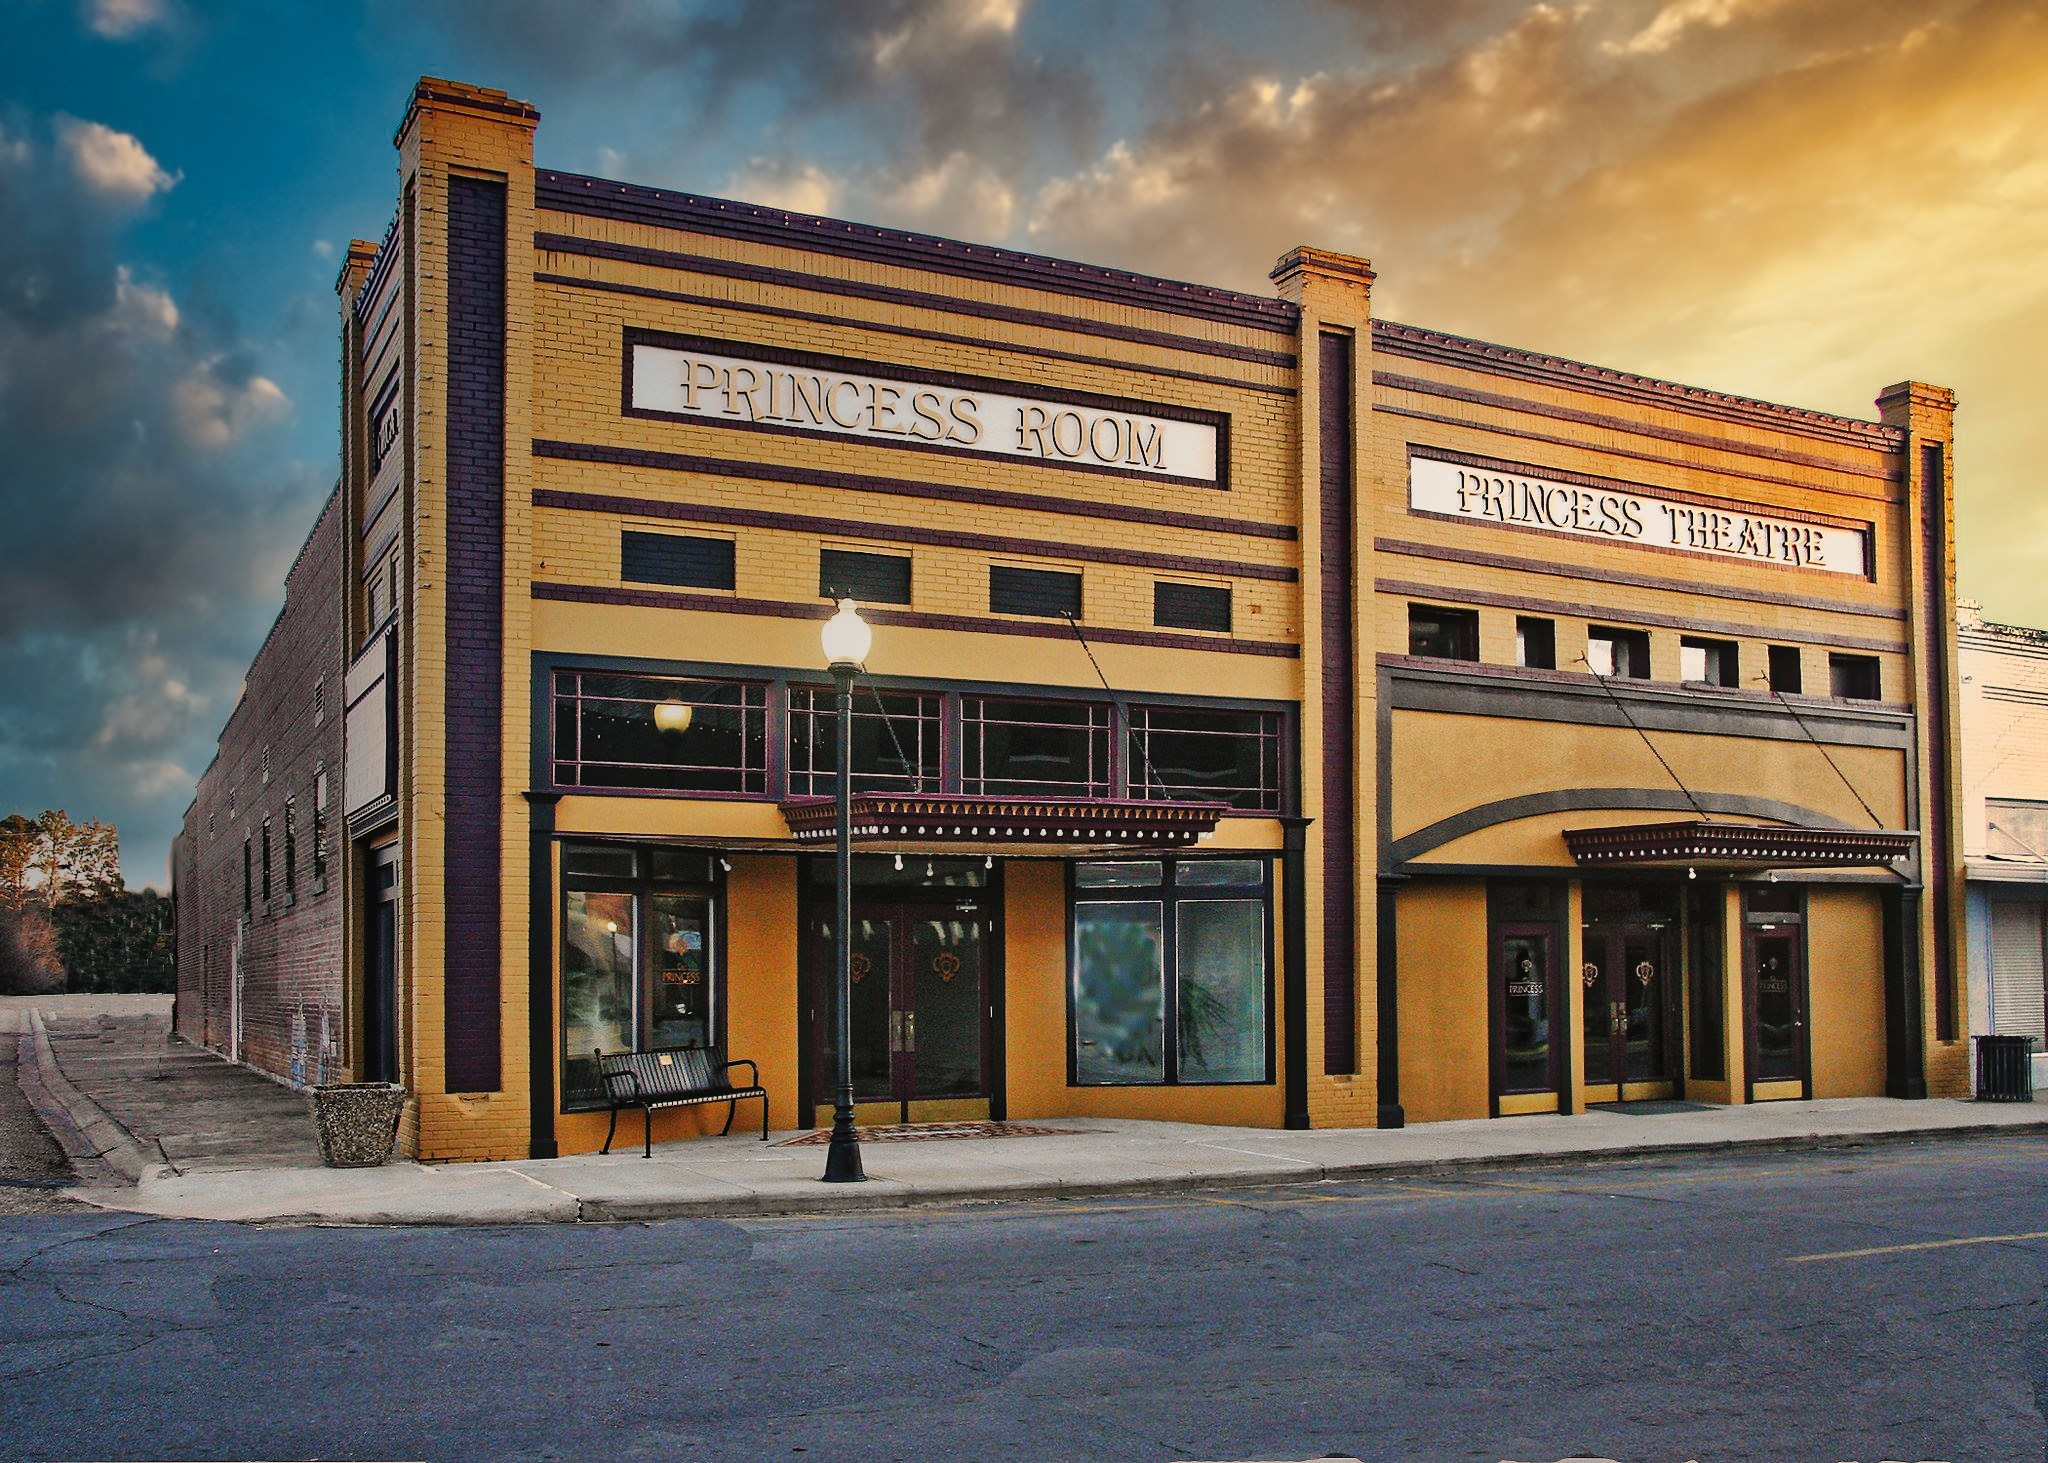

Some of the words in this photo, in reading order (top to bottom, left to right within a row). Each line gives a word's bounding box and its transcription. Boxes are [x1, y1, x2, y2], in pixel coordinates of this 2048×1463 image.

[680, 358, 984, 445] PRINCESS
[1015, 403, 1168, 470] ROOM
[1456, 470, 1644, 538] PRINCESS
[1660, 504, 1827, 567] THEATRE
[1509, 984, 1543, 994] PRINCESS
